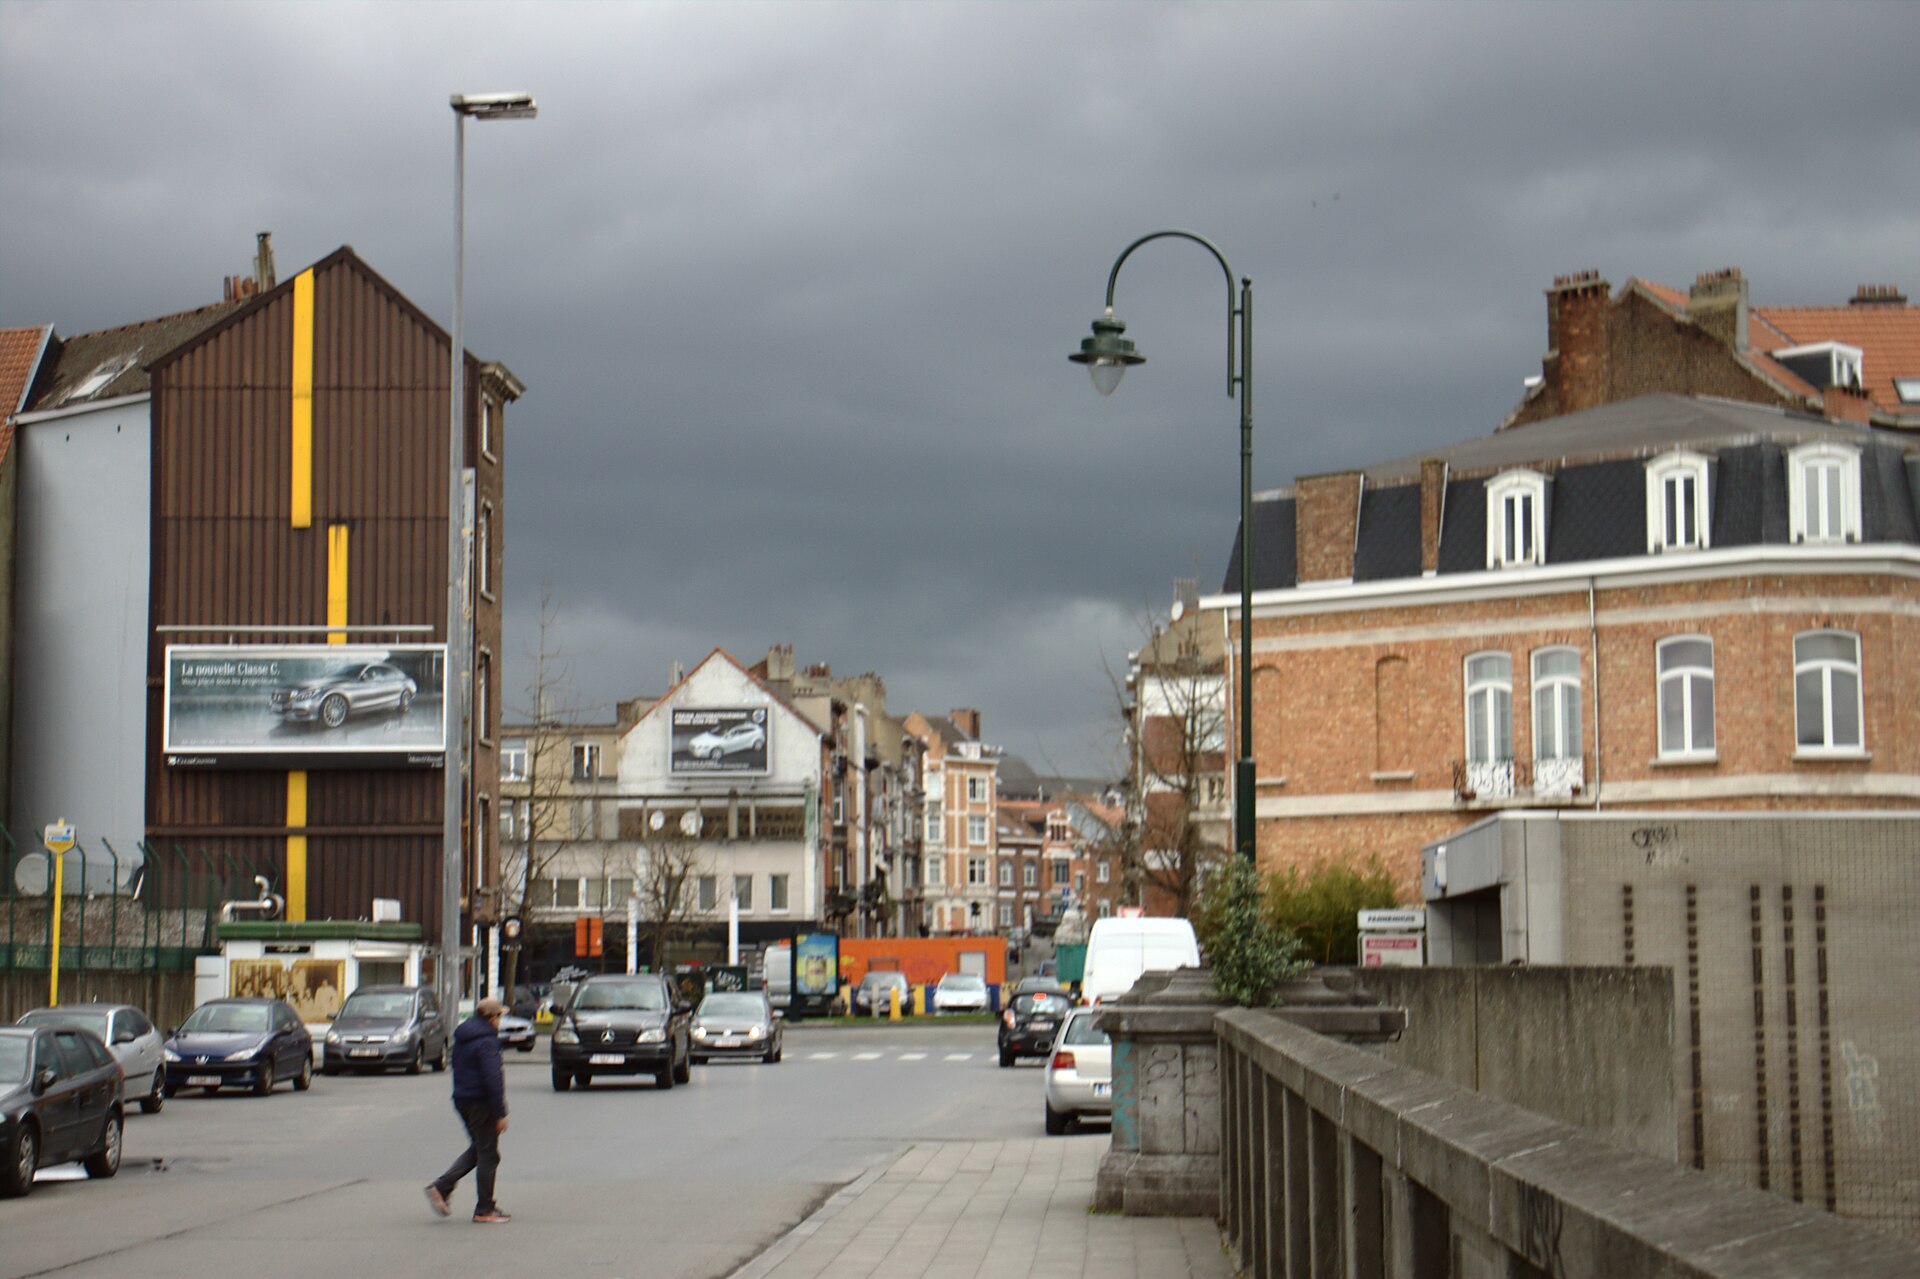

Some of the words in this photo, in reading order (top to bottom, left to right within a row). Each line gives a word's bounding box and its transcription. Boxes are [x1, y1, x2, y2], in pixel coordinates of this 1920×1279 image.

[182, 662, 194, 675] La
[195, 662, 236, 675] nouvelle
[238, 662, 269, 675] Classe
